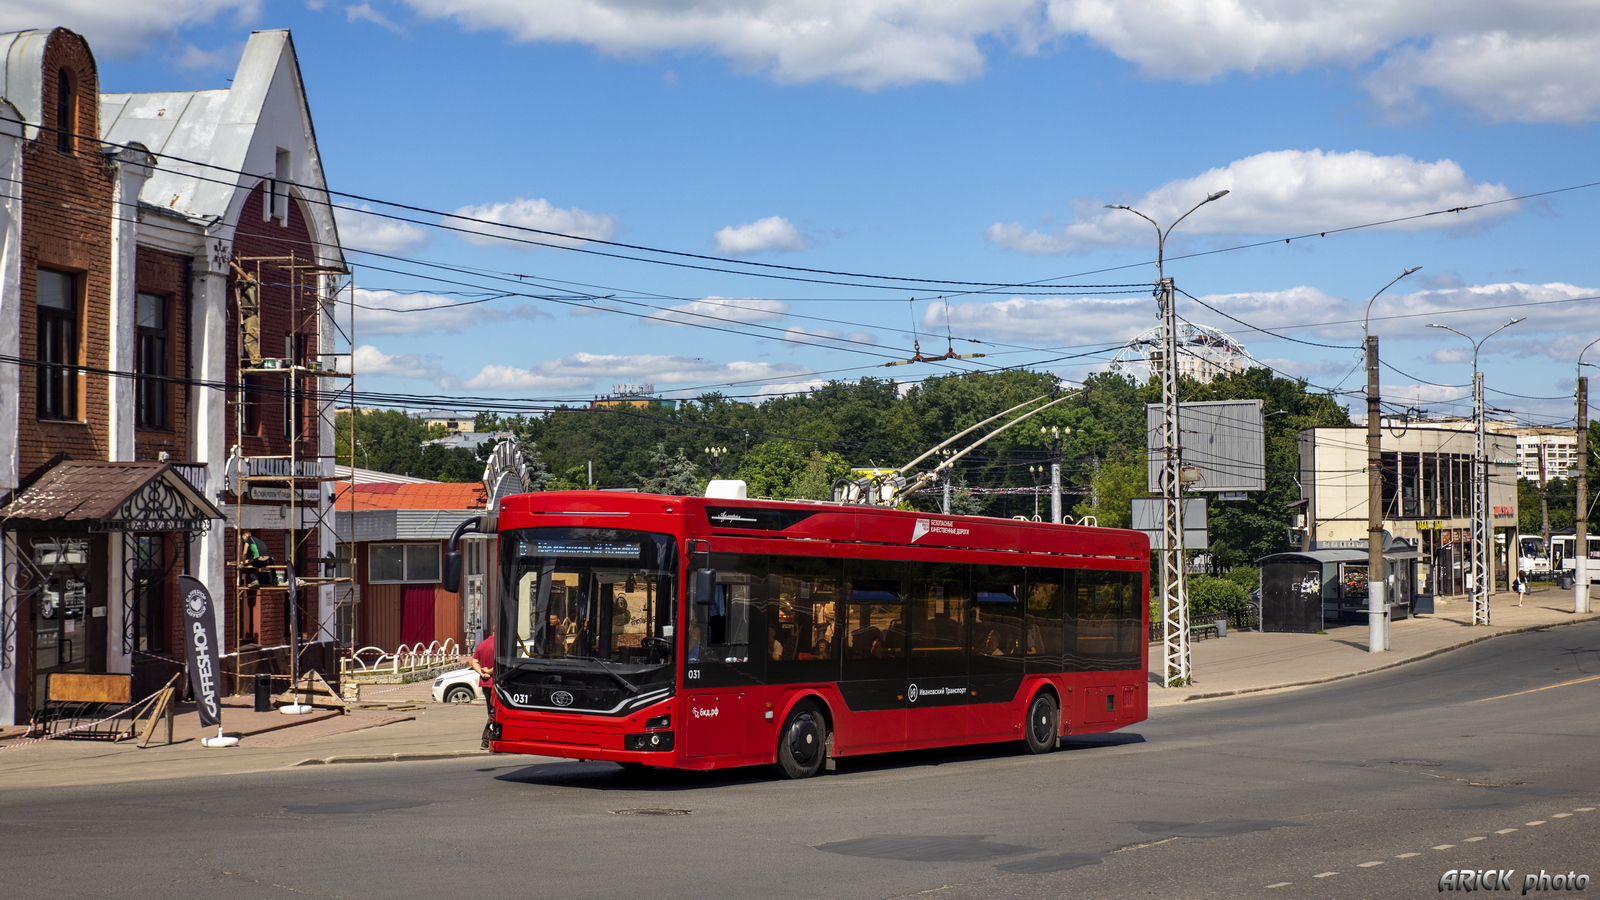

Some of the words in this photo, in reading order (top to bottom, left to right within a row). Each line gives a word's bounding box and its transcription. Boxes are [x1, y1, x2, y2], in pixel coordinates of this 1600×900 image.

[193, 621, 217, 718] CAFFESHOP
[687, 669, 700, 679] 031
[919, 686, 945, 696] Ивановский
[945, 687, 967, 696] Транспорт
[513, 693, 529, 704] 031
